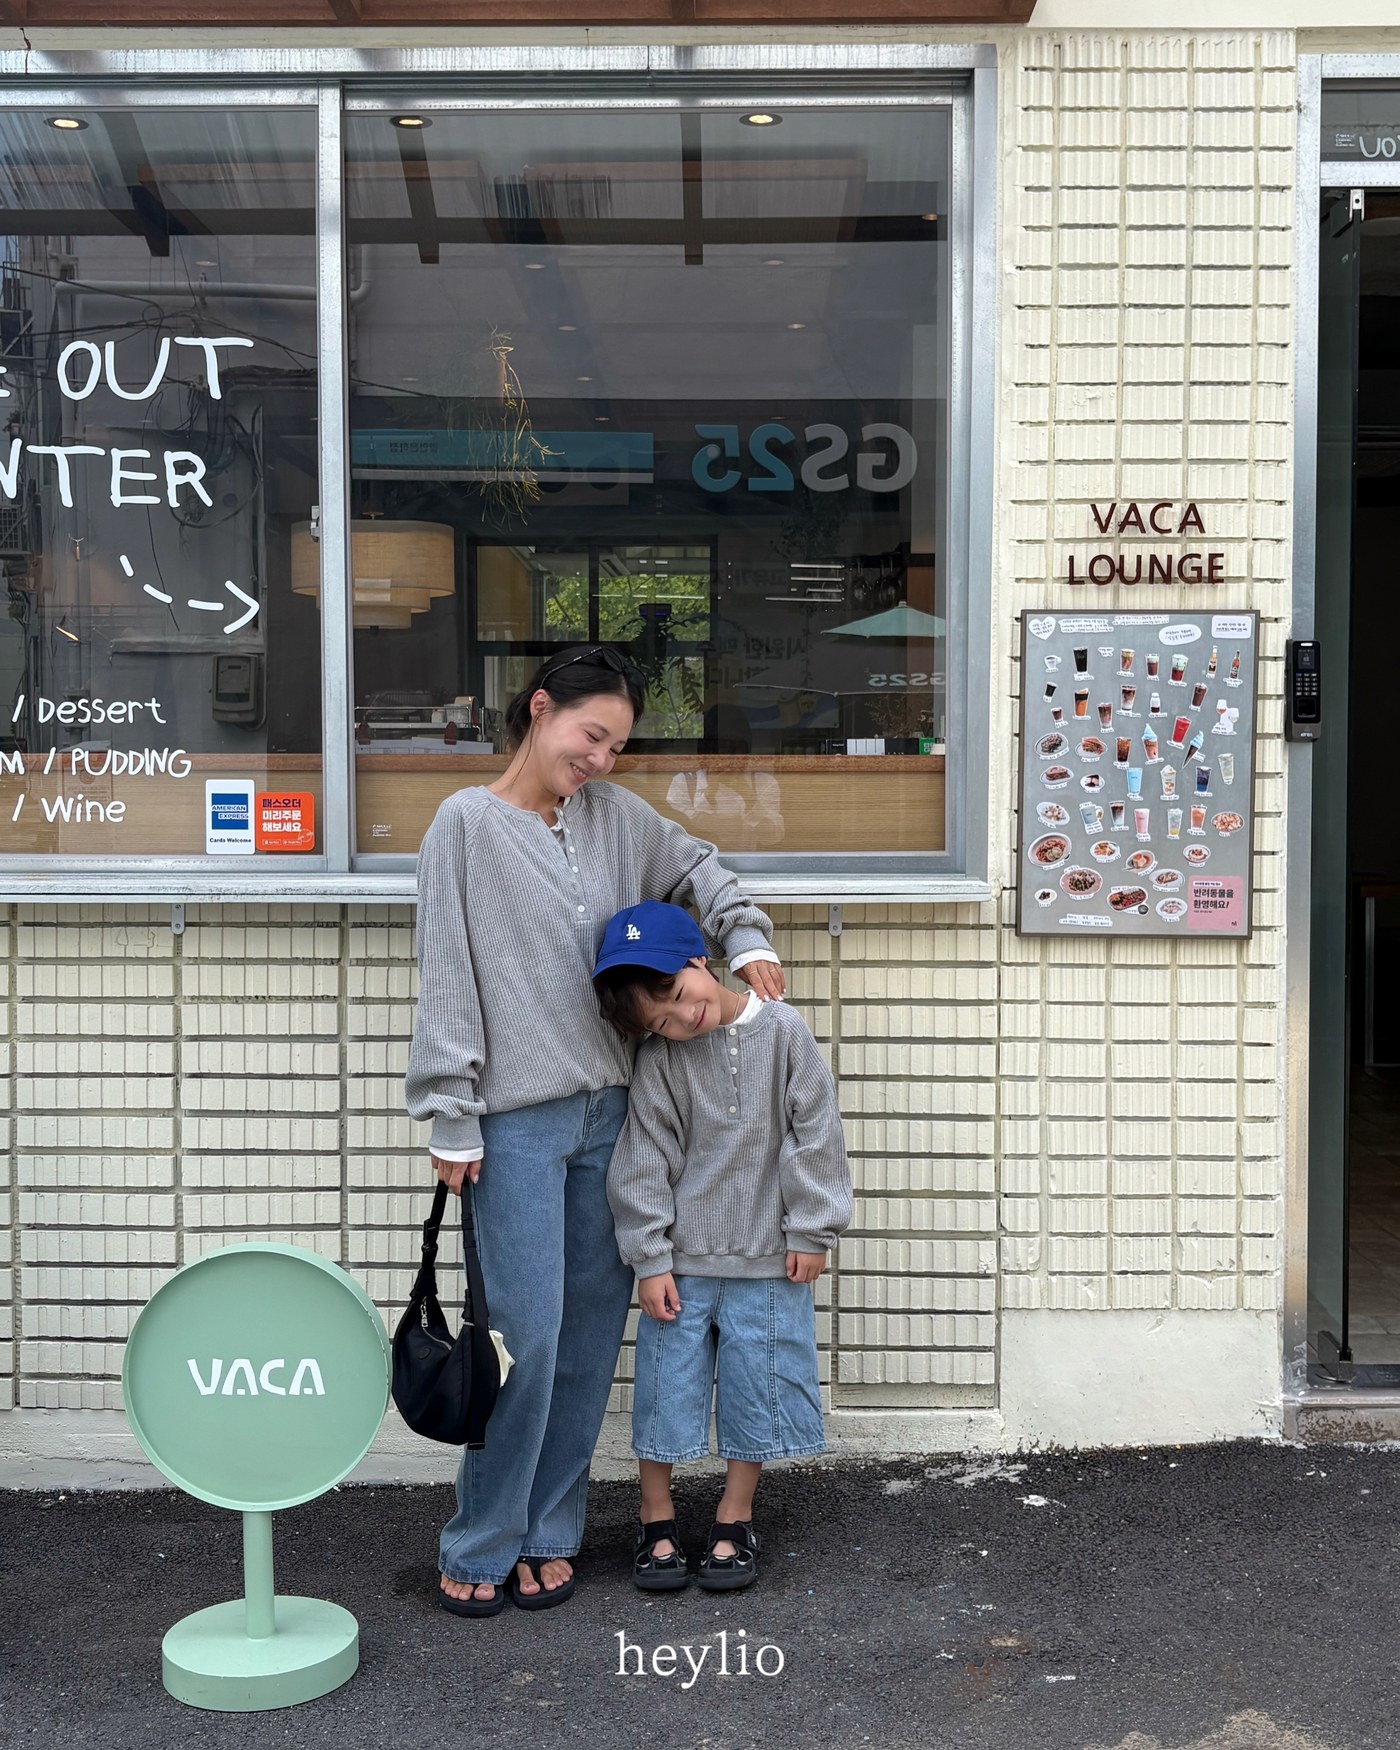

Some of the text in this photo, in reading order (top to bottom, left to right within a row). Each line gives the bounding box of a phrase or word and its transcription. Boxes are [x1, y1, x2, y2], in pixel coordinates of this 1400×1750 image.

[57, 337, 254, 400] OUT
[1091, 502, 1206, 534] VACA
[1068, 553, 1225, 585] LOUNGE
[38, 697, 167, 724] Dessert
[71, 747, 192, 778] PUDDING
[41, 793, 127, 823] Wine
[262, 798, 302, 808] 패스오더
[262, 810, 302, 821] 미리주문
[262, 822, 302, 833] 해보세요
[1193, 888, 1234, 899] 반려동물을
[1193, 899, 1230, 909] 환영해요!
[626, 924, 641, 940] LA
[187, 1358, 326, 1396] VACA
